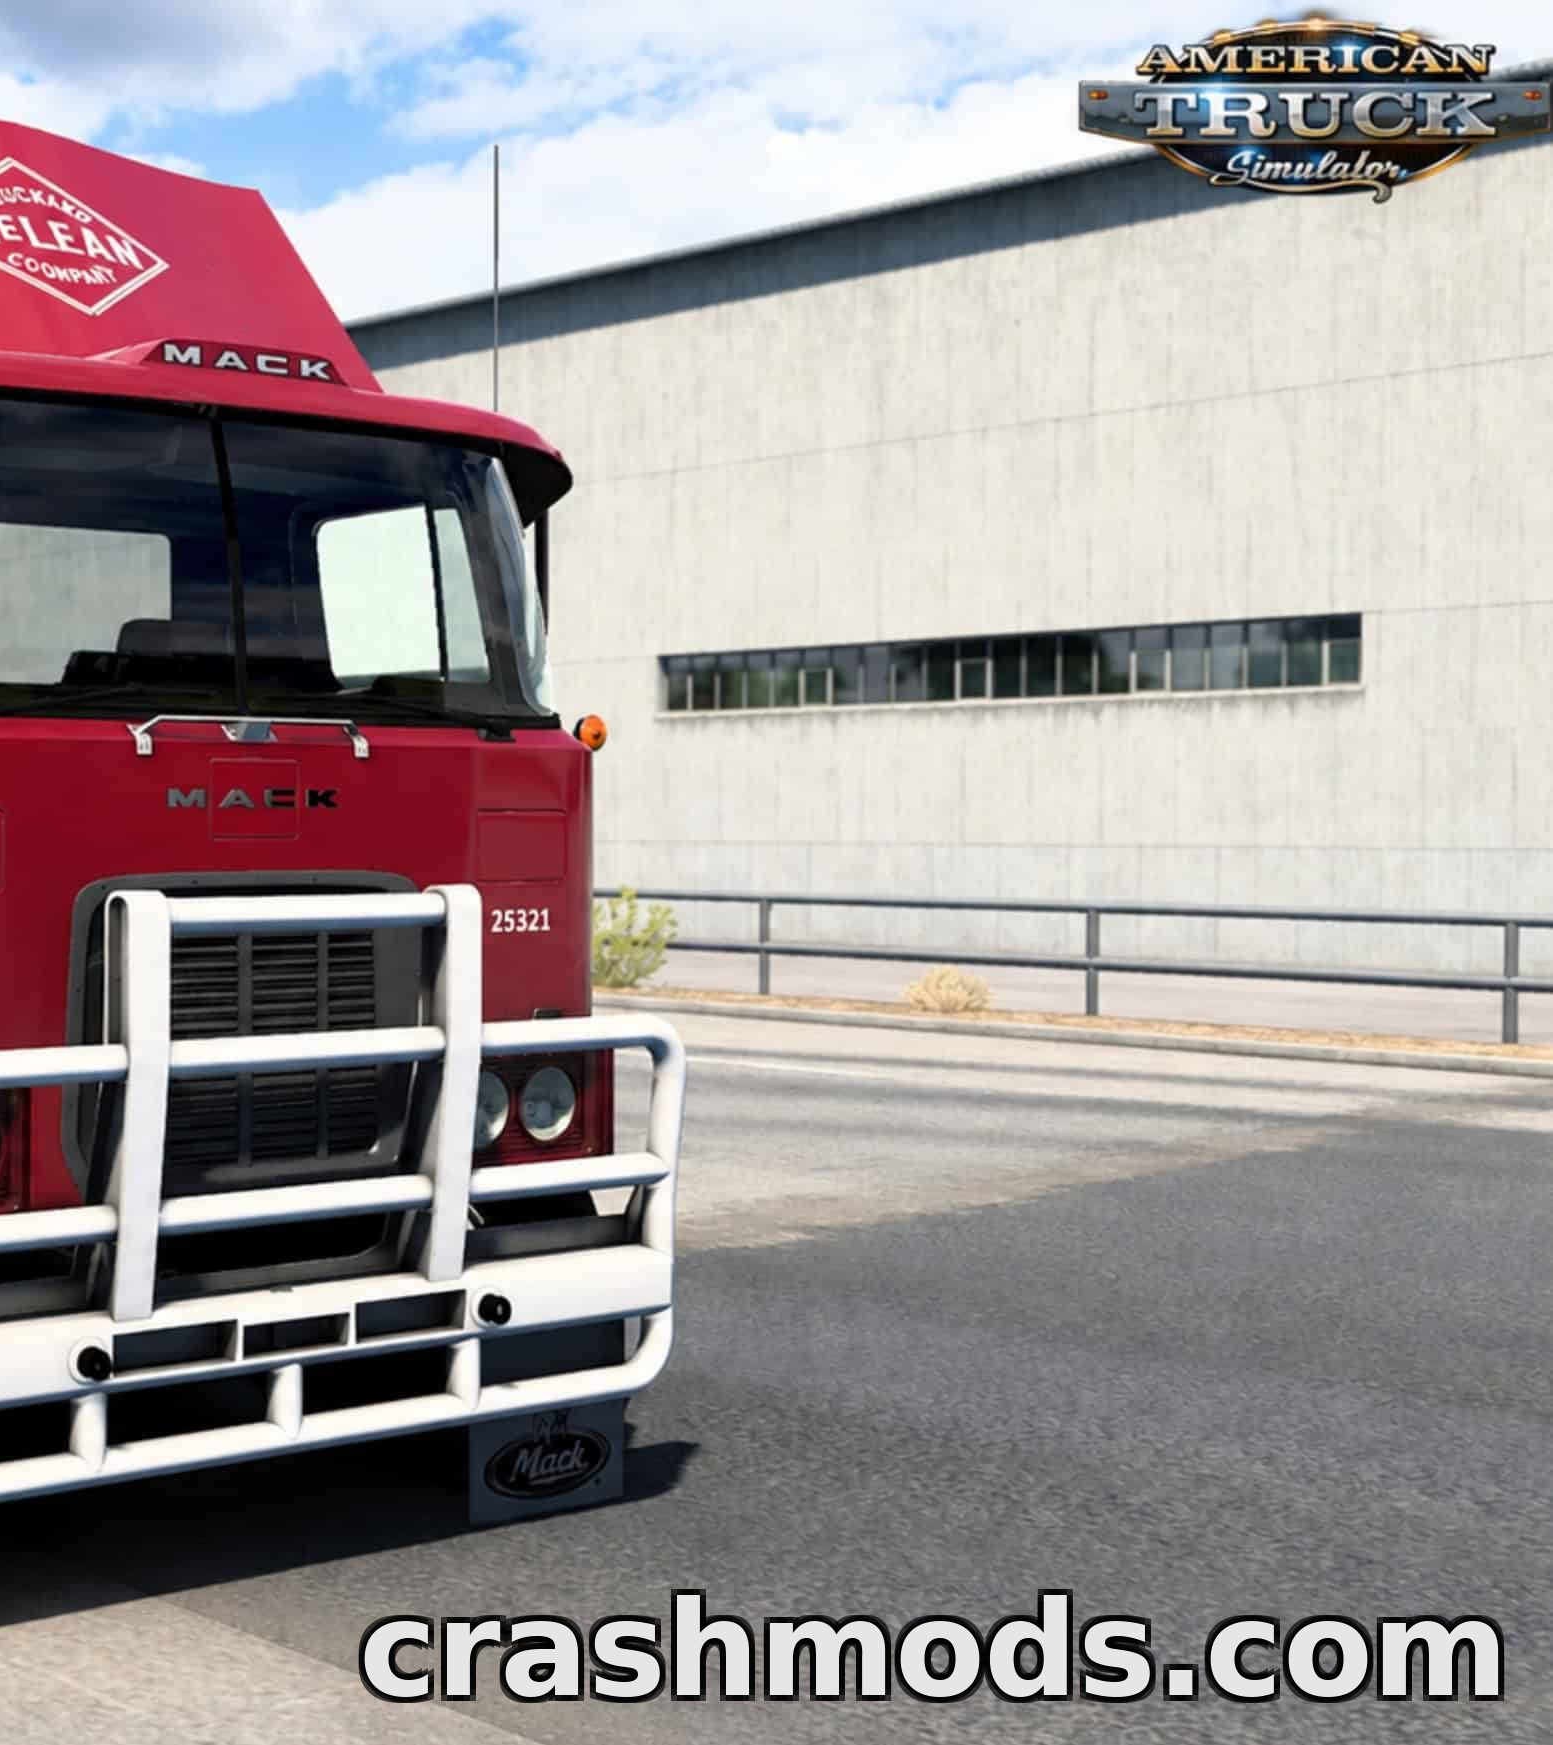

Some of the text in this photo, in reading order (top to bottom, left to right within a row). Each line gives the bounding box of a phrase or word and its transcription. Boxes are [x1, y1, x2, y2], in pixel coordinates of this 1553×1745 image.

[163, 343, 332, 381] MACK
[166, 788, 340, 809] MACK
[491, 908, 552, 934] 25321
[509, 1439, 590, 1484] Mack
